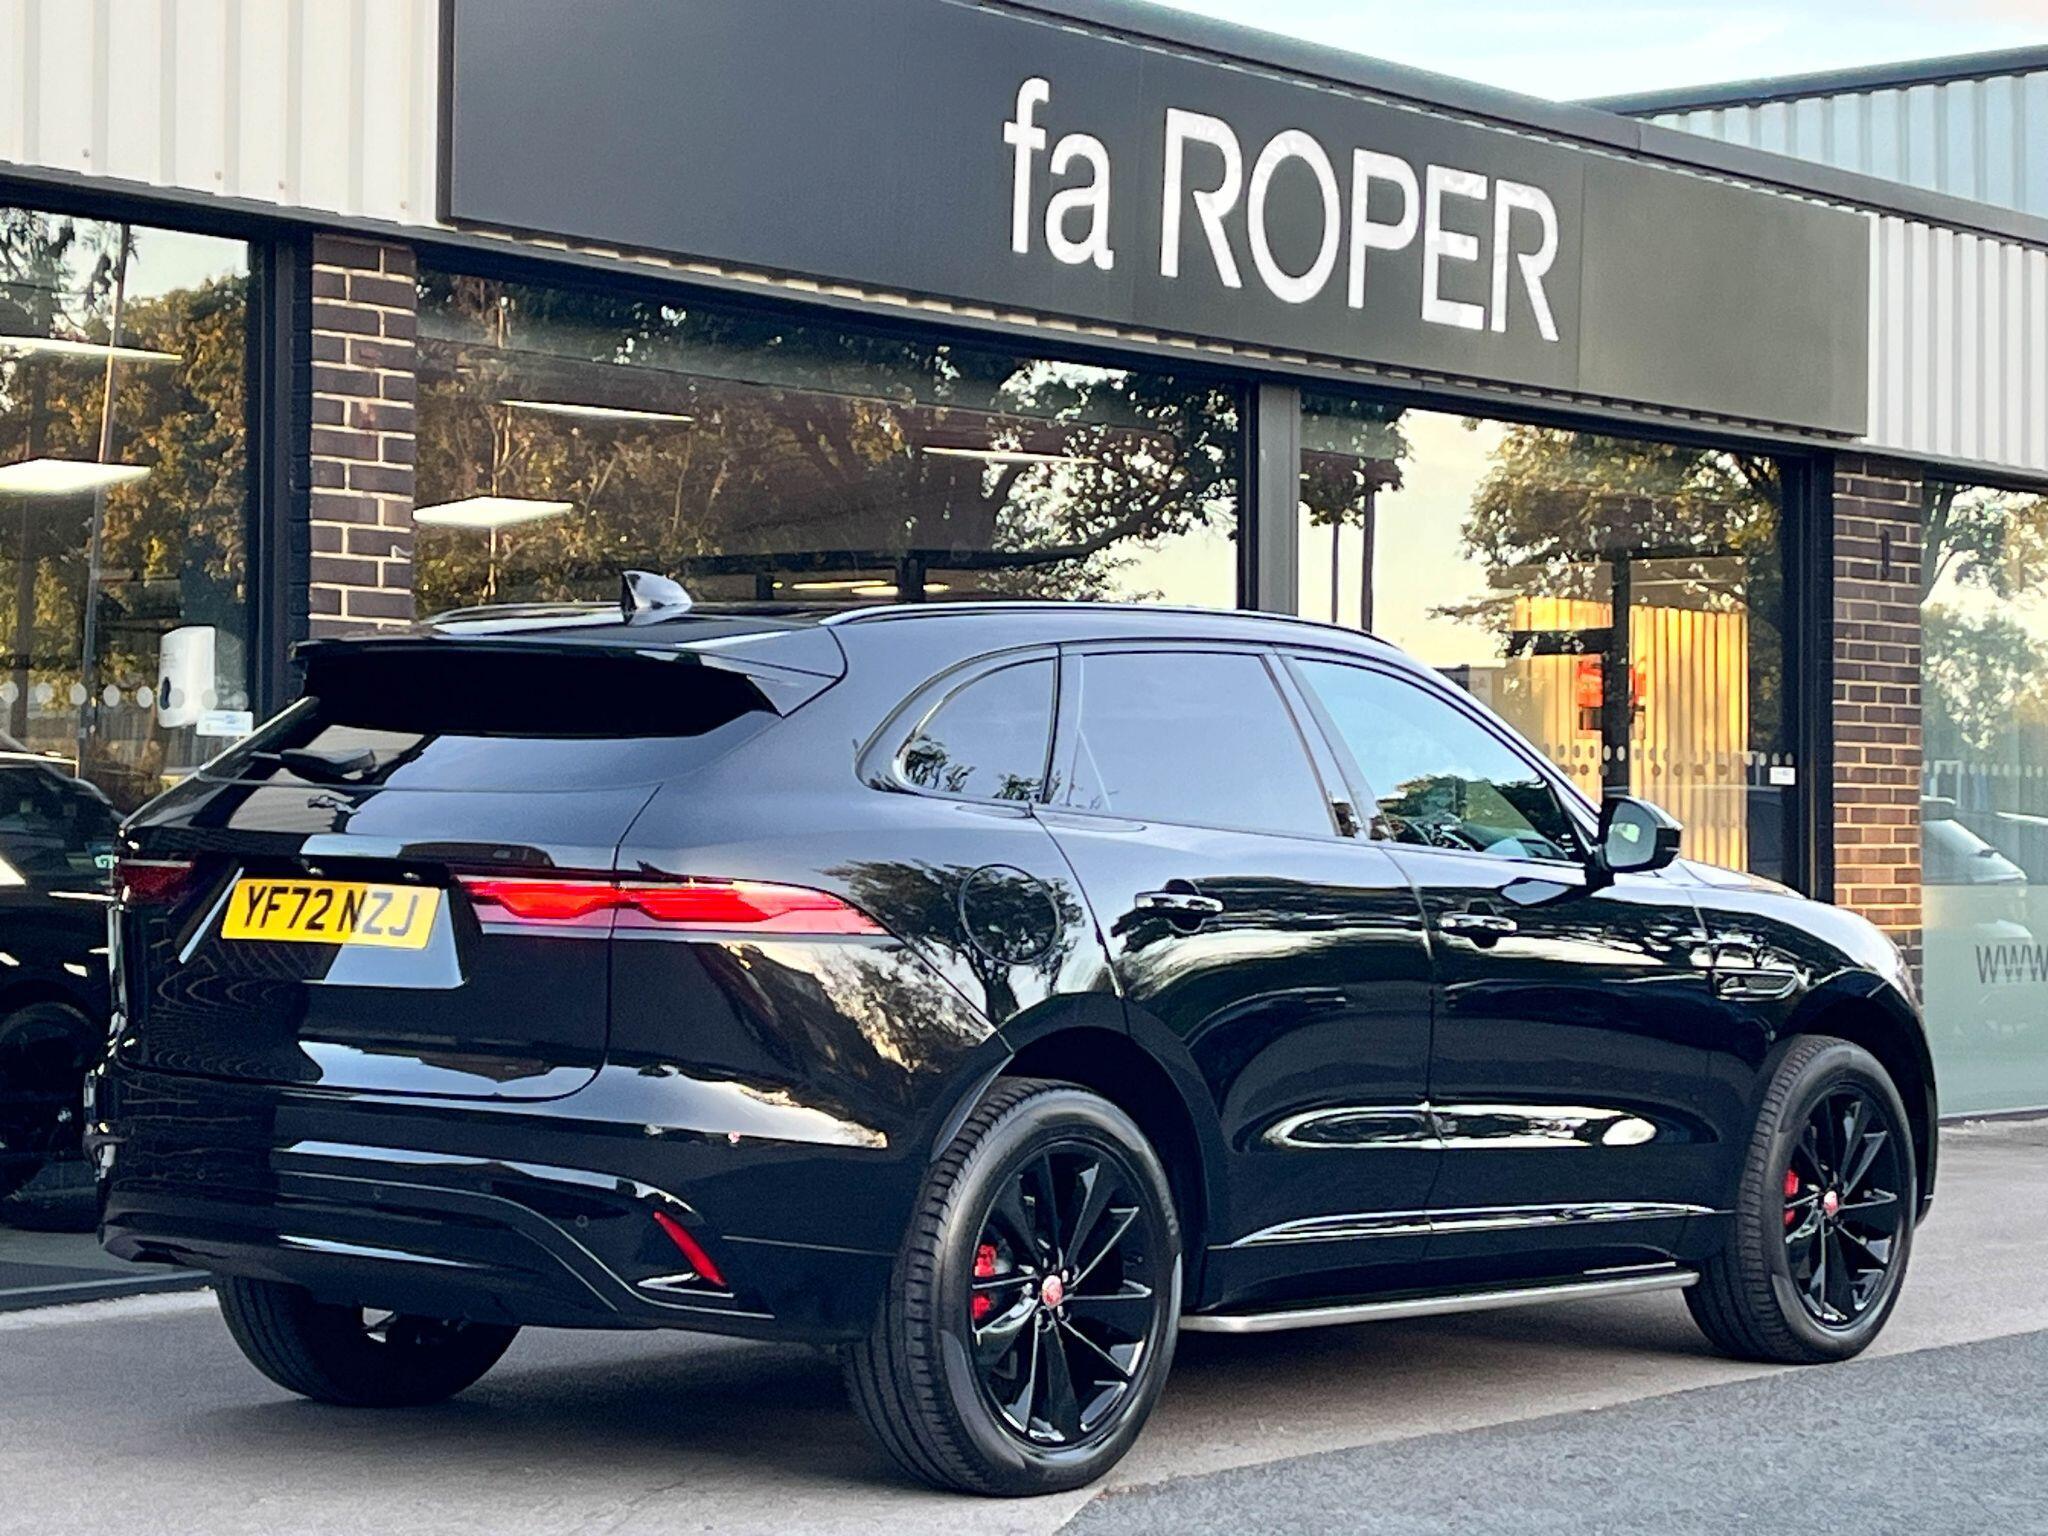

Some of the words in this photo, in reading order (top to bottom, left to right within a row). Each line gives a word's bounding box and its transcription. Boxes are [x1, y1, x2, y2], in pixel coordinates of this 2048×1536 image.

[1003, 77, 1114, 271] fa
[1160, 107, 1559, 343] ROPER
[244, 885, 334, 931] YF72
[336, 889, 419, 937] NZJ
